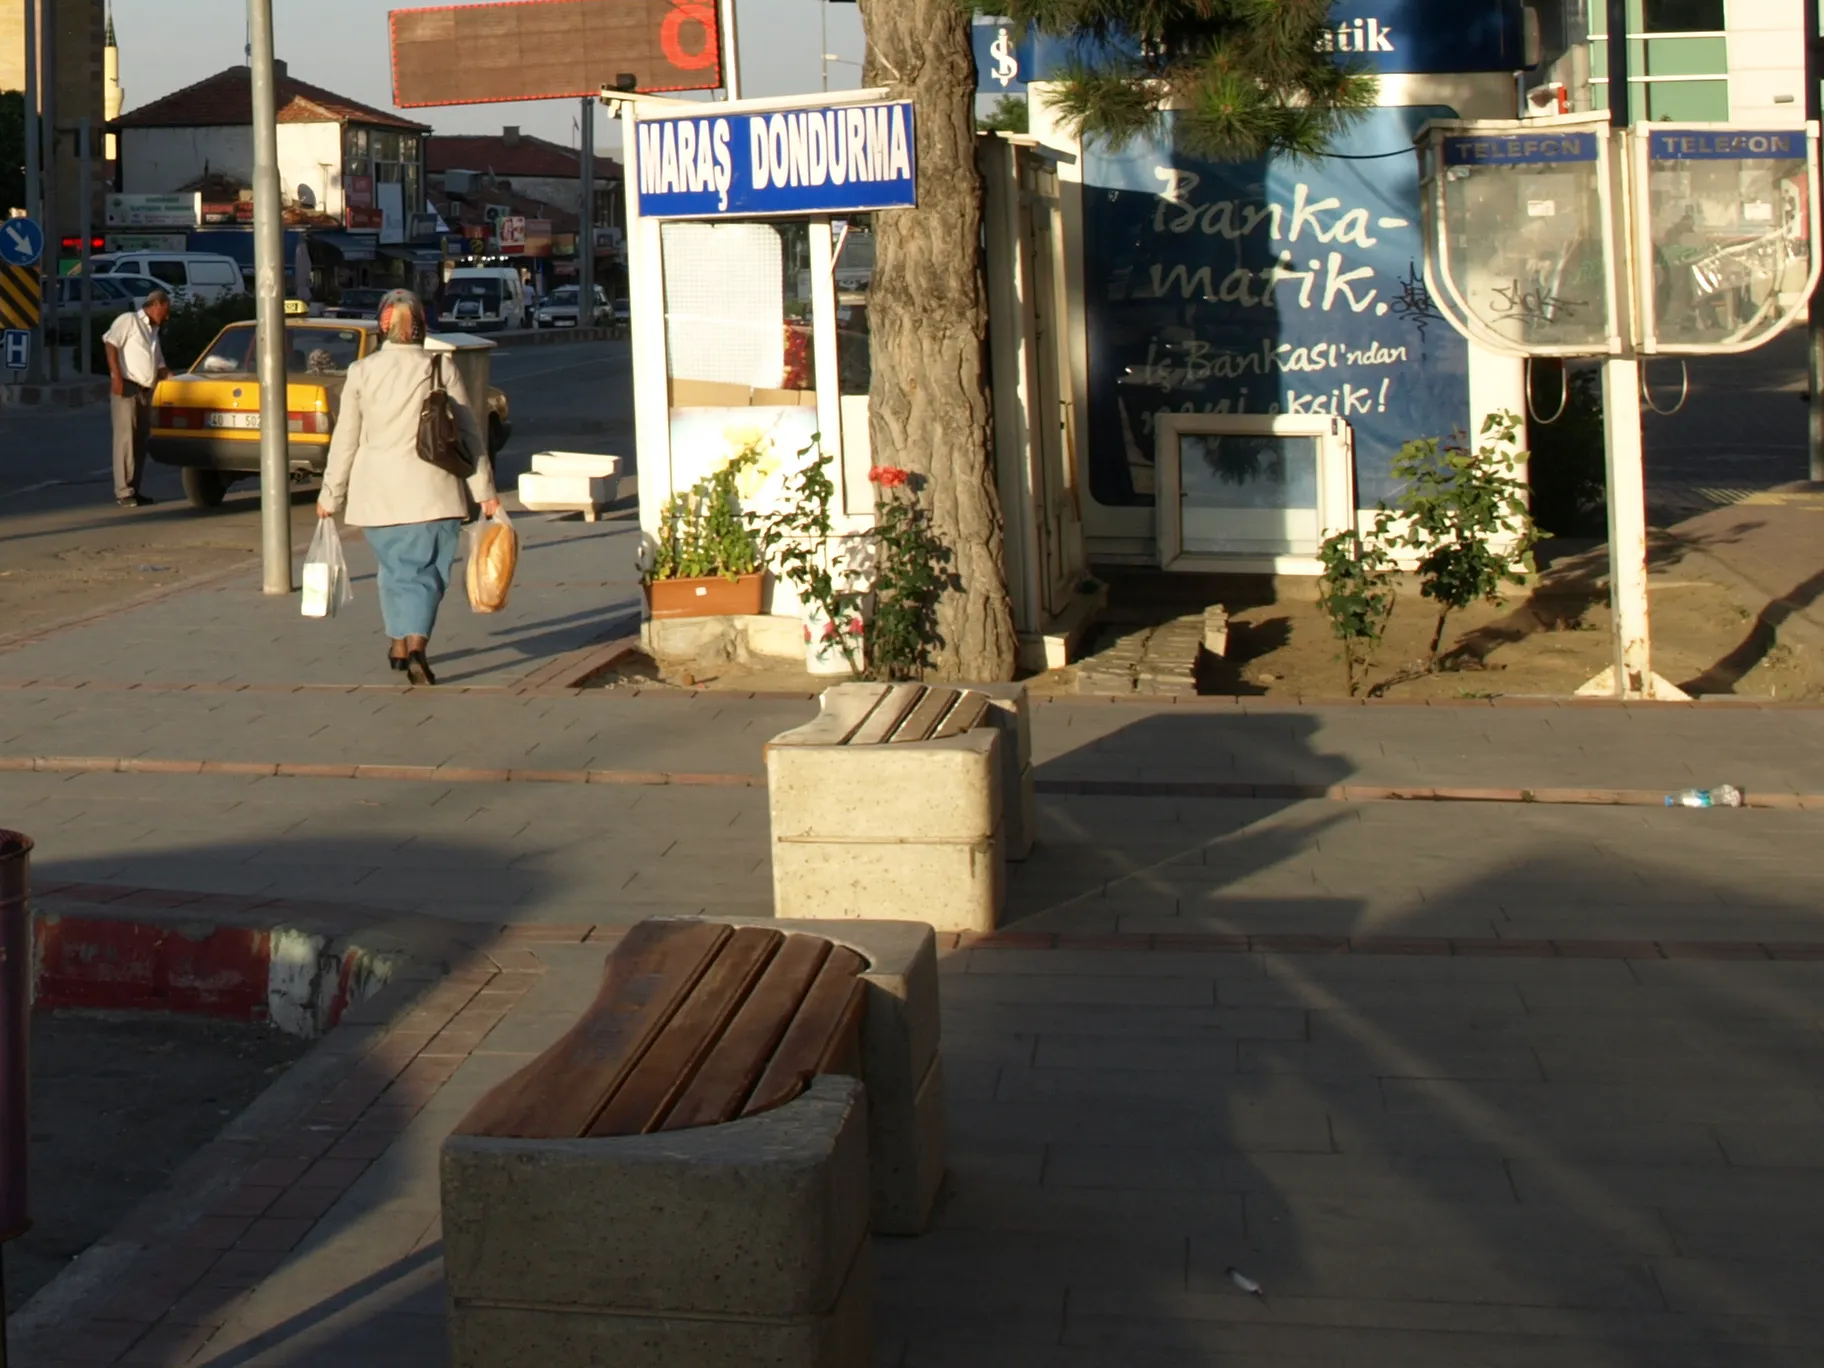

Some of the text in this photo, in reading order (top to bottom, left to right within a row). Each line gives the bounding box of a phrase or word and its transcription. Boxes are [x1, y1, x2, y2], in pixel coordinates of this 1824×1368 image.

[638, 104, 912, 211] MARAŞ DONDURMA
[1456, 139, 1581, 160] TELEFON
[1662, 135, 1792, 154] TELEFON
[1152, 165, 1409, 249] Banka-
[1148, 249, 1390, 317] matik.
